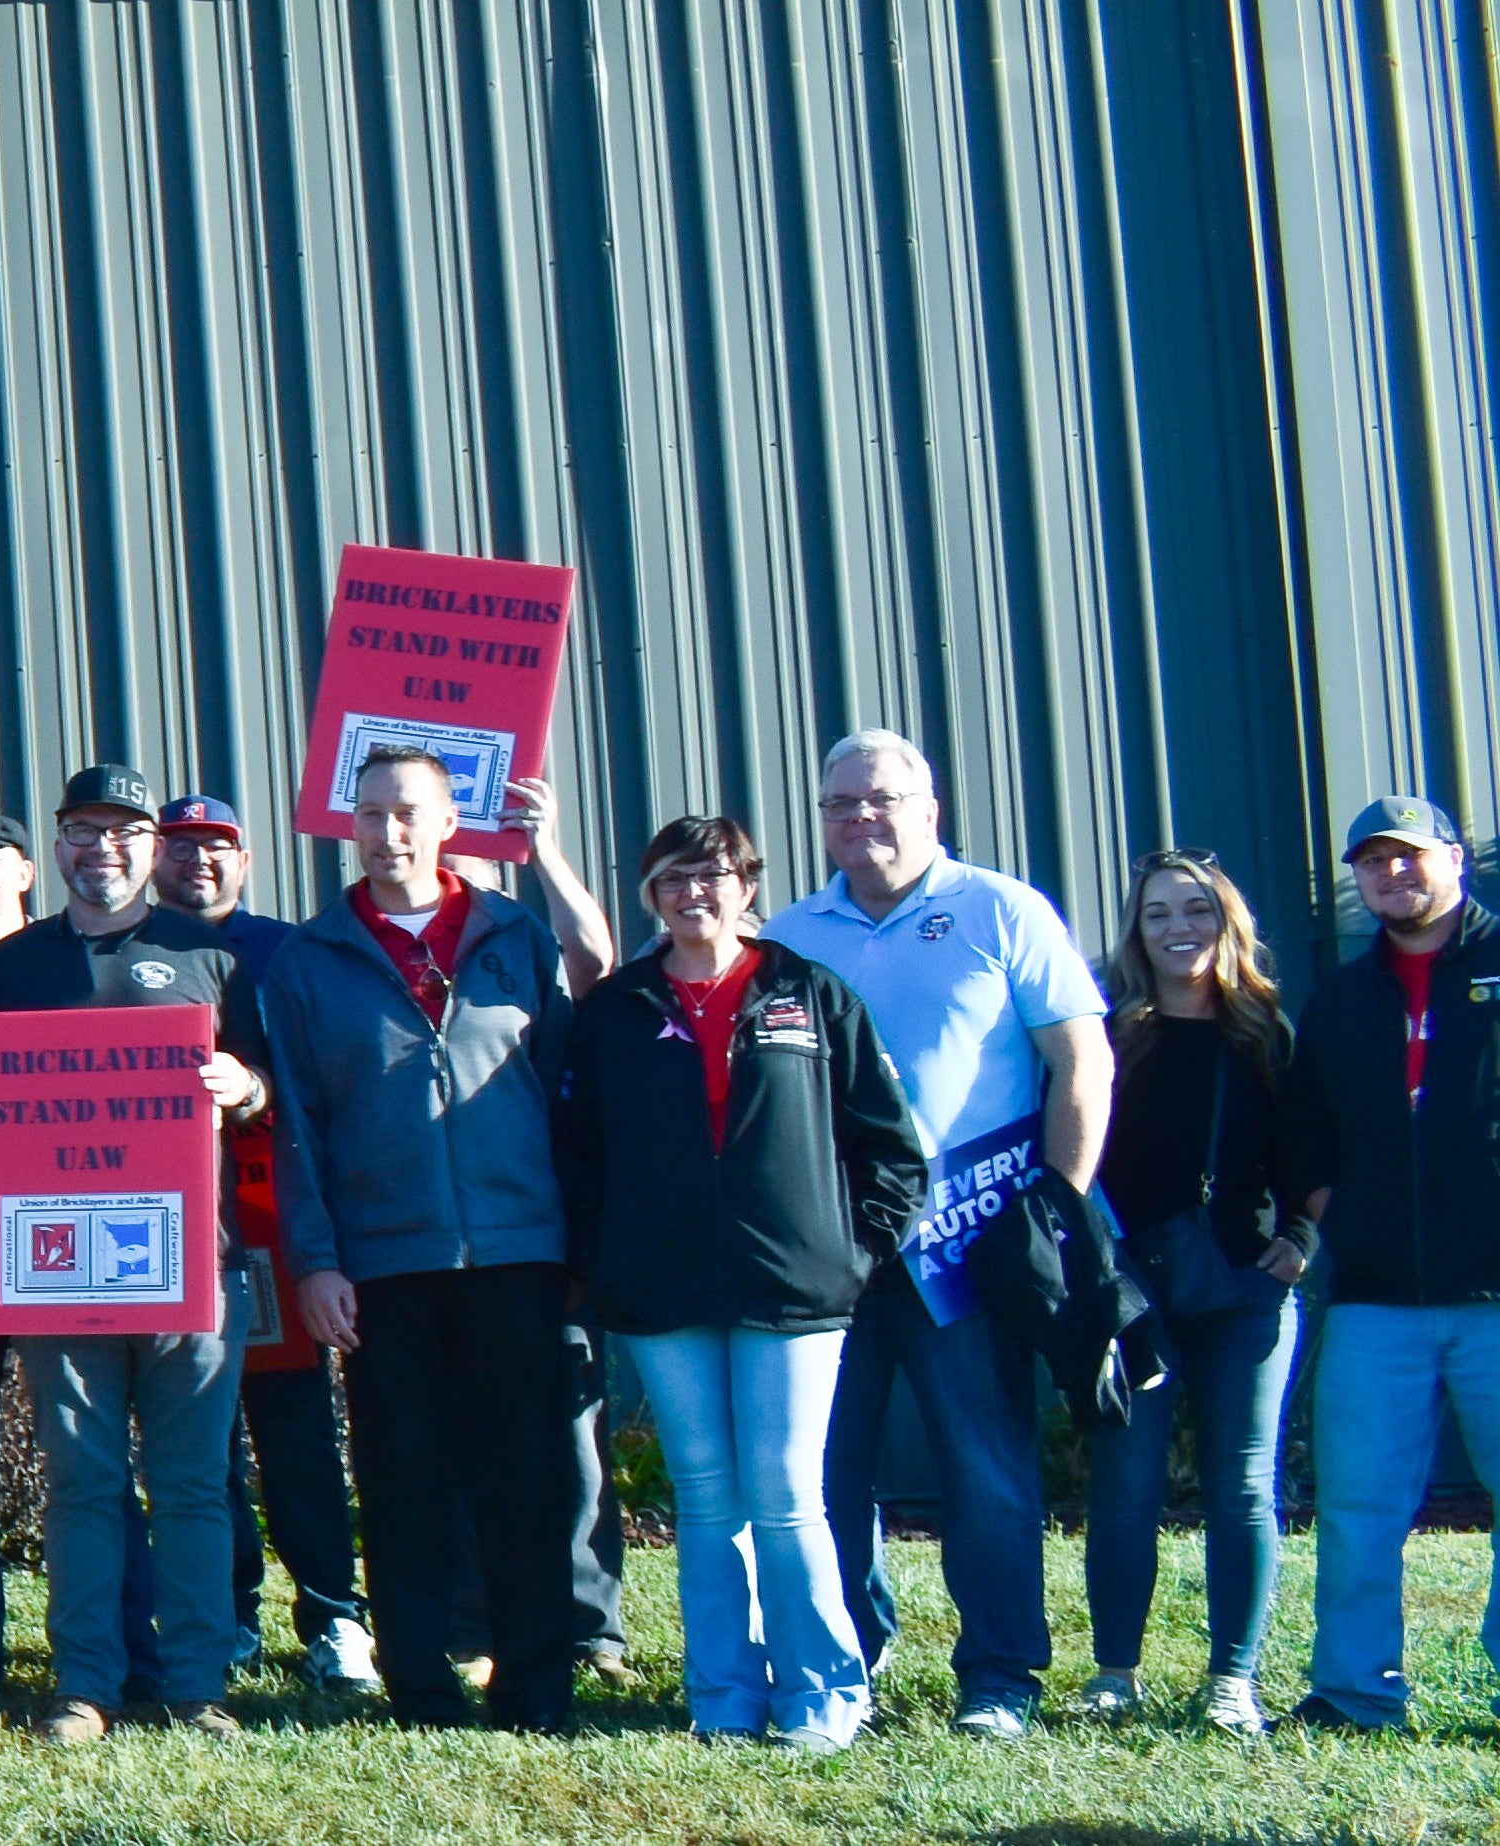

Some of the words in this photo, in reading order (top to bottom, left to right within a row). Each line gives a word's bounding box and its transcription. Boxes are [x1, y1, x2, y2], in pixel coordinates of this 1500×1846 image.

[344, 579, 562, 625] BRICKLAYERS
[347, 626, 449, 657] STAND
[458, 637, 542, 669] WITH
[404, 676, 472, 704] UAW
[117, 778, 145, 805] 15
[105, 1094, 194, 1120] WITH
[55, 1145, 129, 1171] UAW
[932, 1139, 1032, 1211] EVERY
[19, 1199, 47, 1207] Union
[50, 1198, 59, 1206] of
[61, 1198, 113, 1207] Bricklayers
[116, 1197, 134, 1206] and
[136, 1197, 163, 1205] Allied
[917, 1189, 1003, 1251] AUTO
[4, 1216, 13, 1286] International
[170, 1212, 180, 1286] Craftworkers
